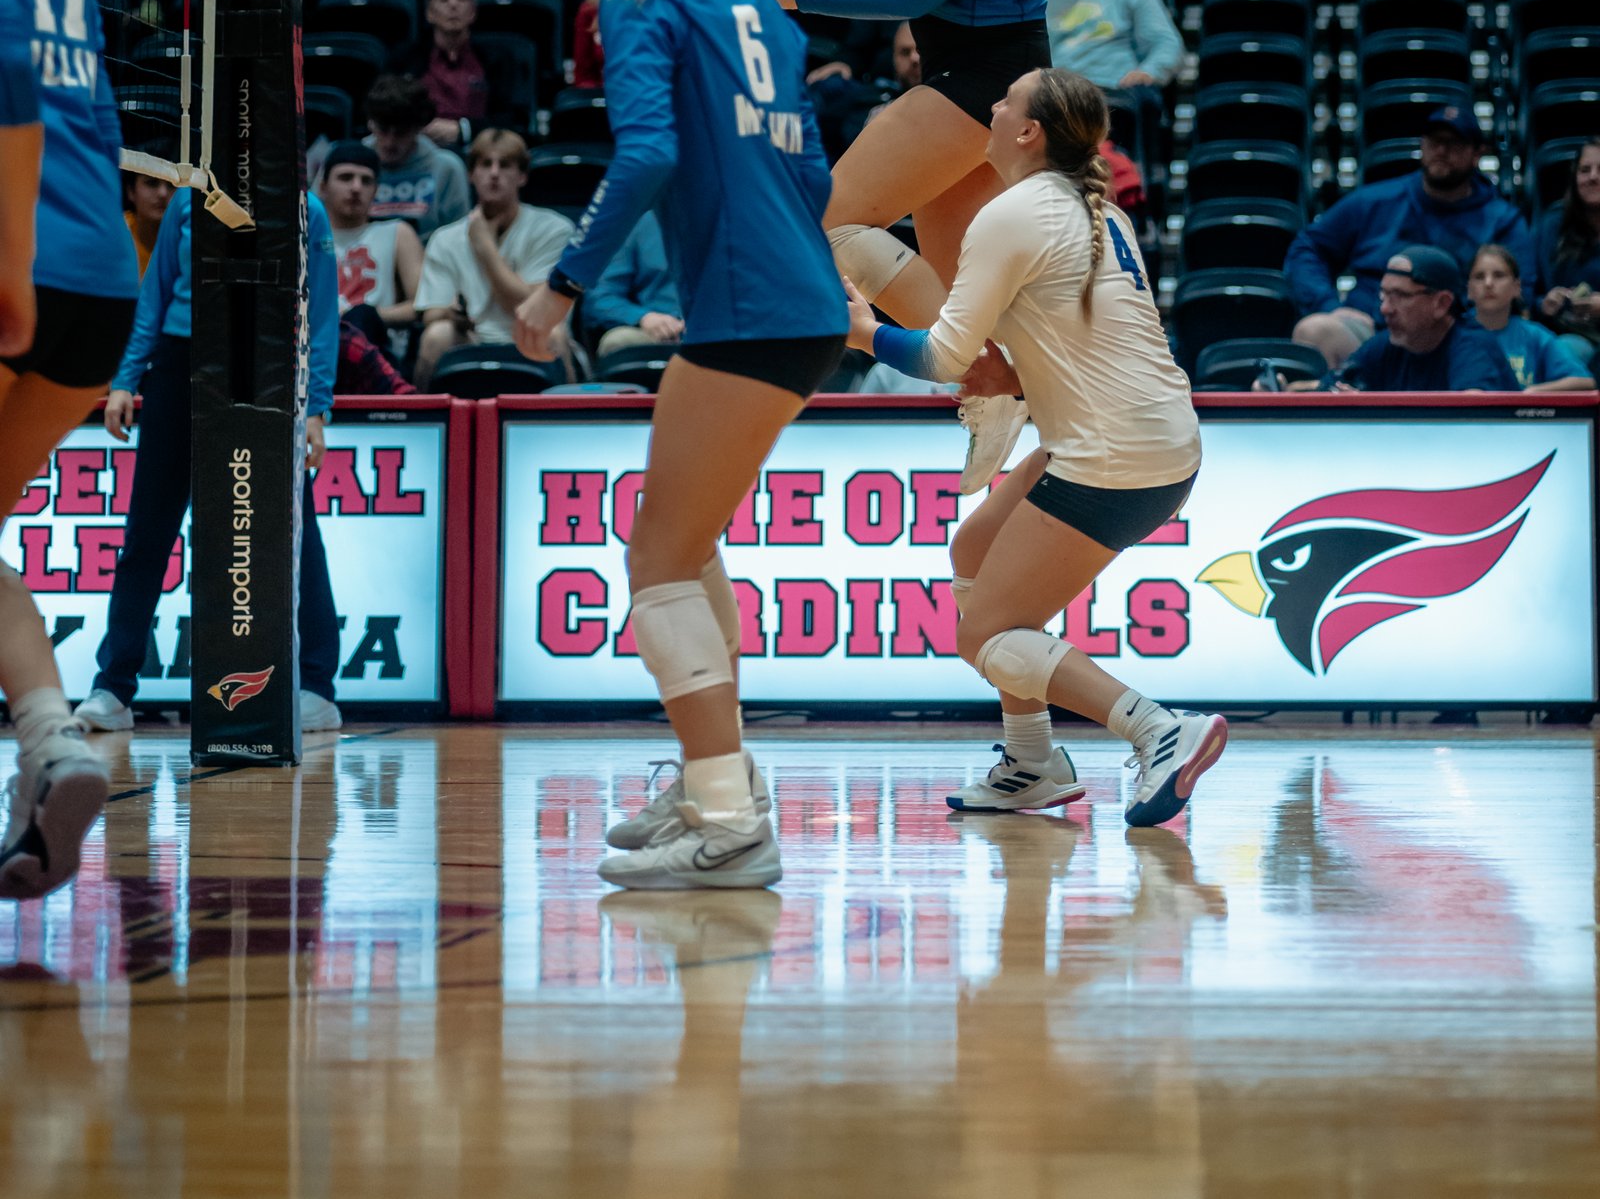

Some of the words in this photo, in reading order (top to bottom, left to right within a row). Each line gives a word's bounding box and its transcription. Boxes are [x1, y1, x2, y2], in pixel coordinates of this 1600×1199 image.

[731, 3, 777, 104] 6
[1106, 217, 1147, 291] 4
[228, 447, 254, 531] sports
[844, 470, 966, 547] OF
[227, 534, 254, 637] imports
